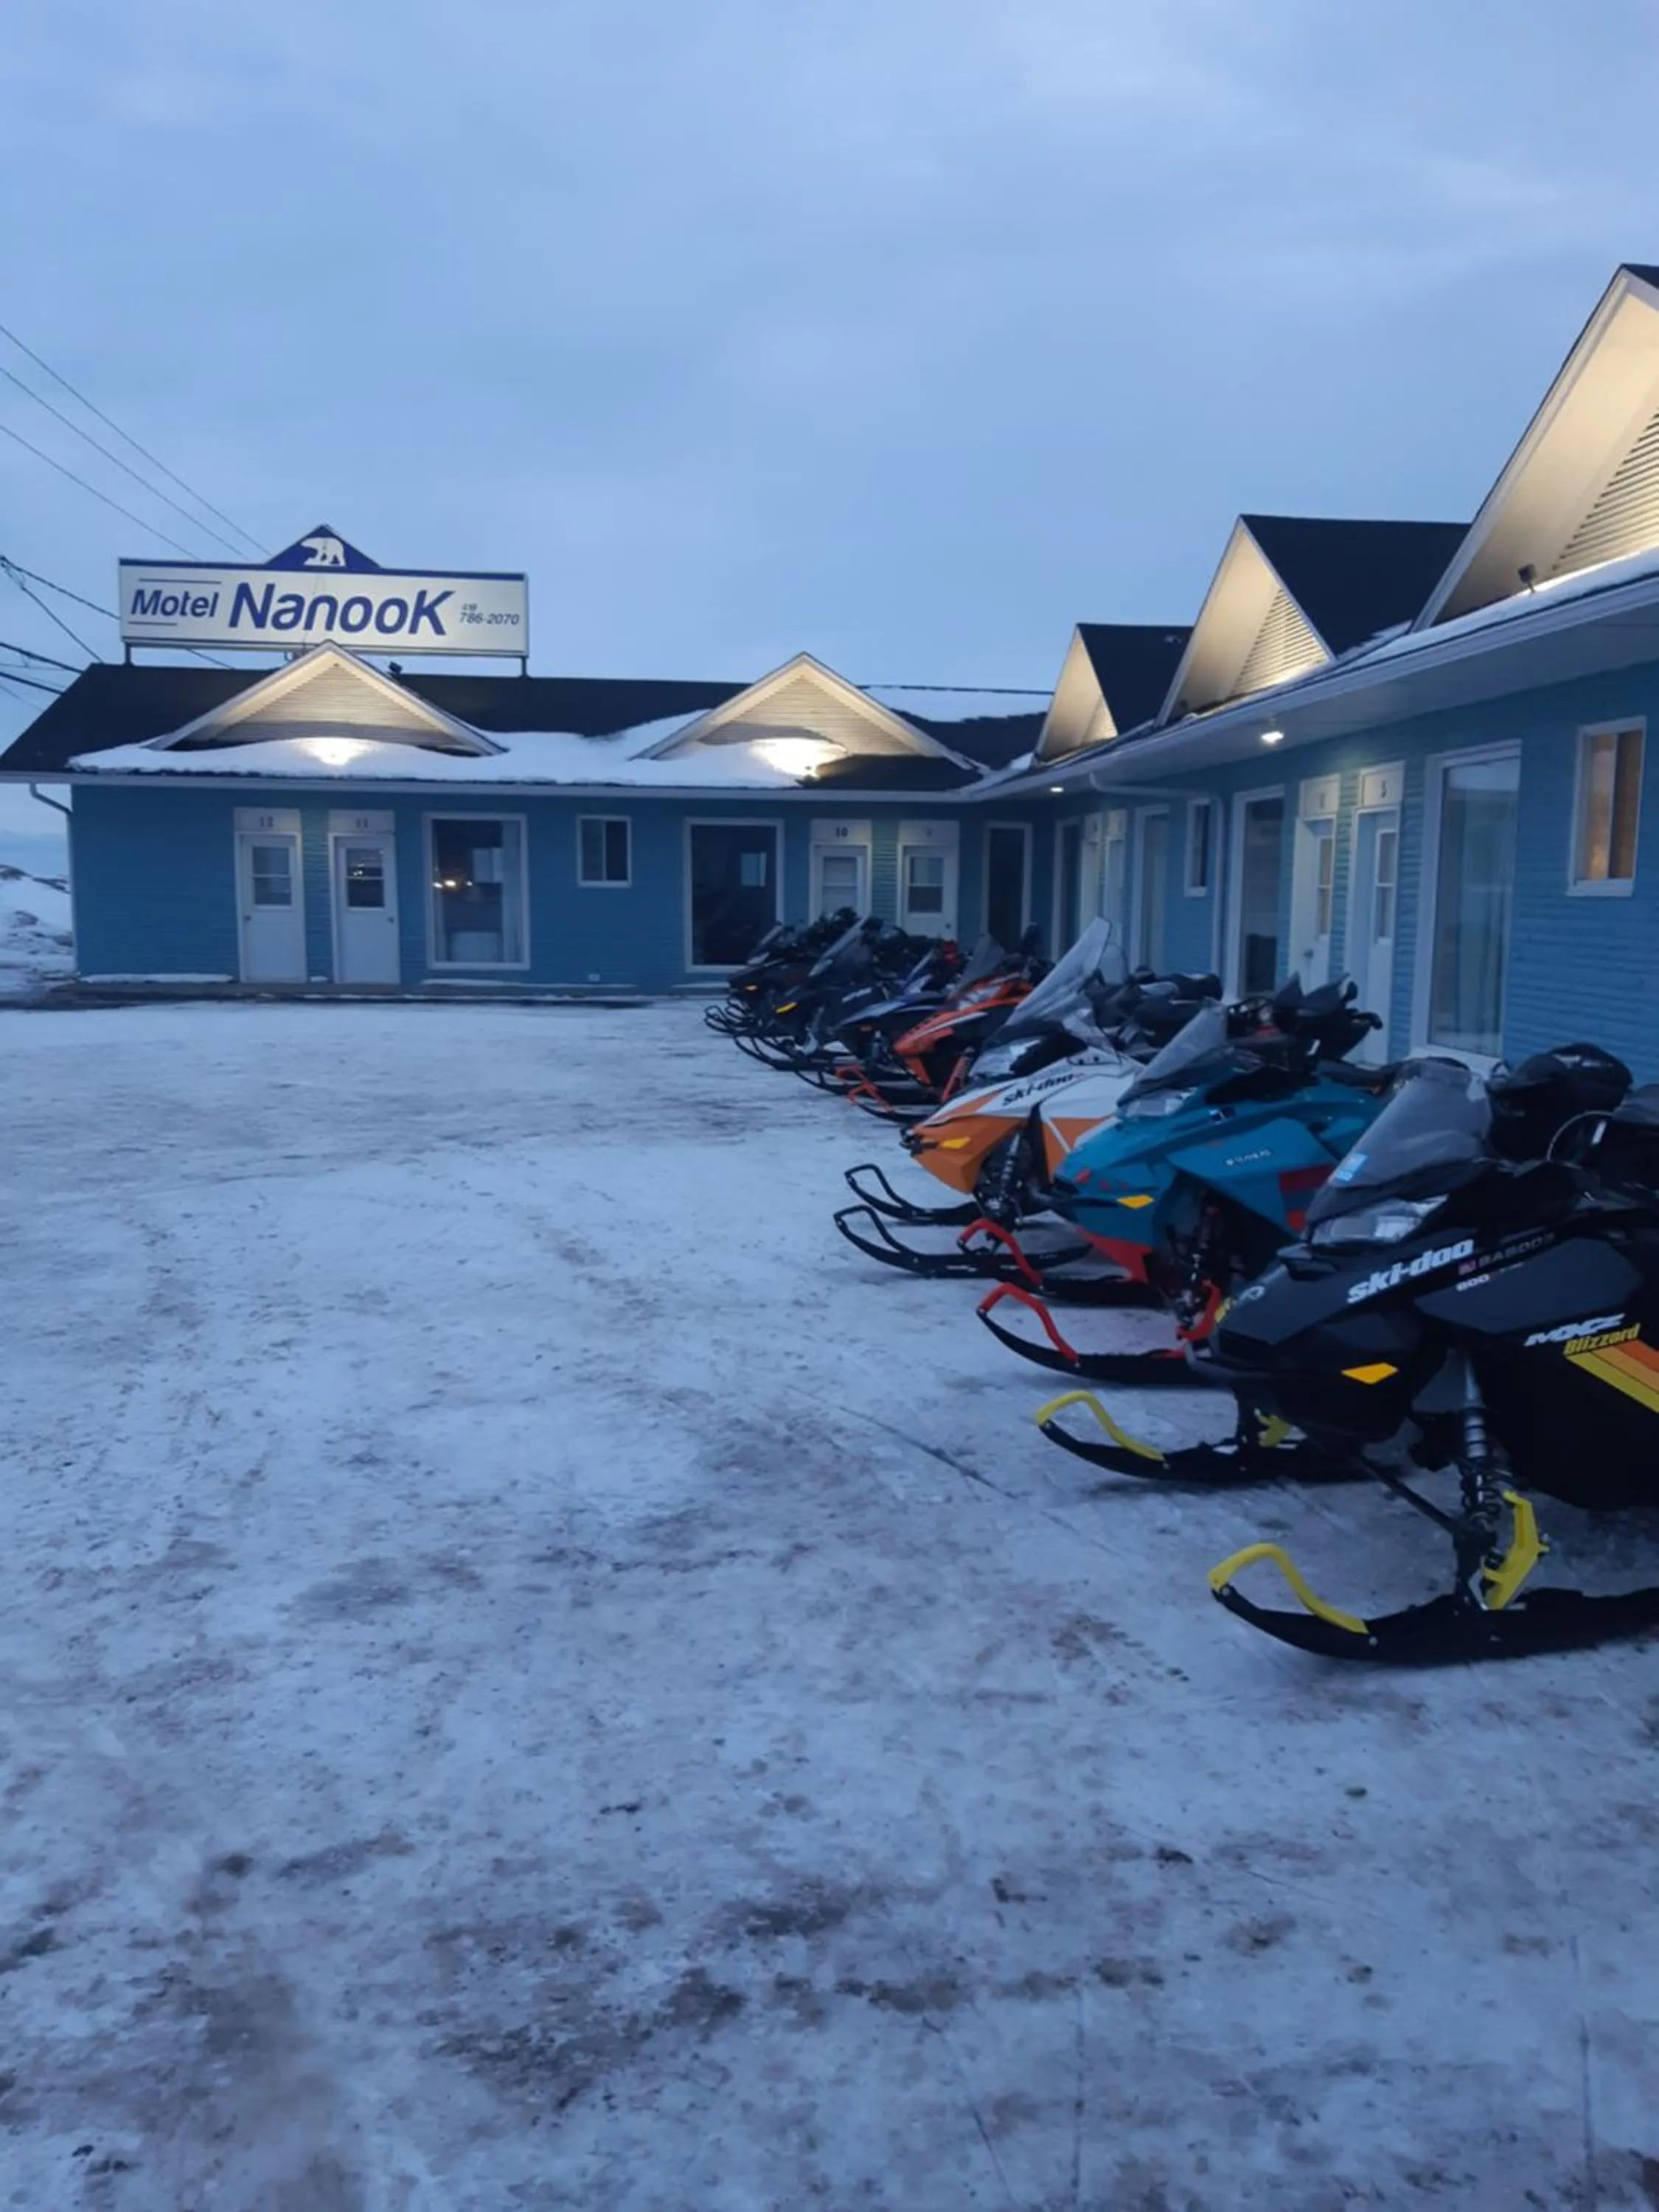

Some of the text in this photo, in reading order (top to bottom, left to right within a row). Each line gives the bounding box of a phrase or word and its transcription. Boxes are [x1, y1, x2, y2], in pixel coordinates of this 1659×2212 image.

[130, 582, 455, 635] Motel NanooK
[460, 612, 520, 625] 786-2070
[835, 827, 849, 838] 10
